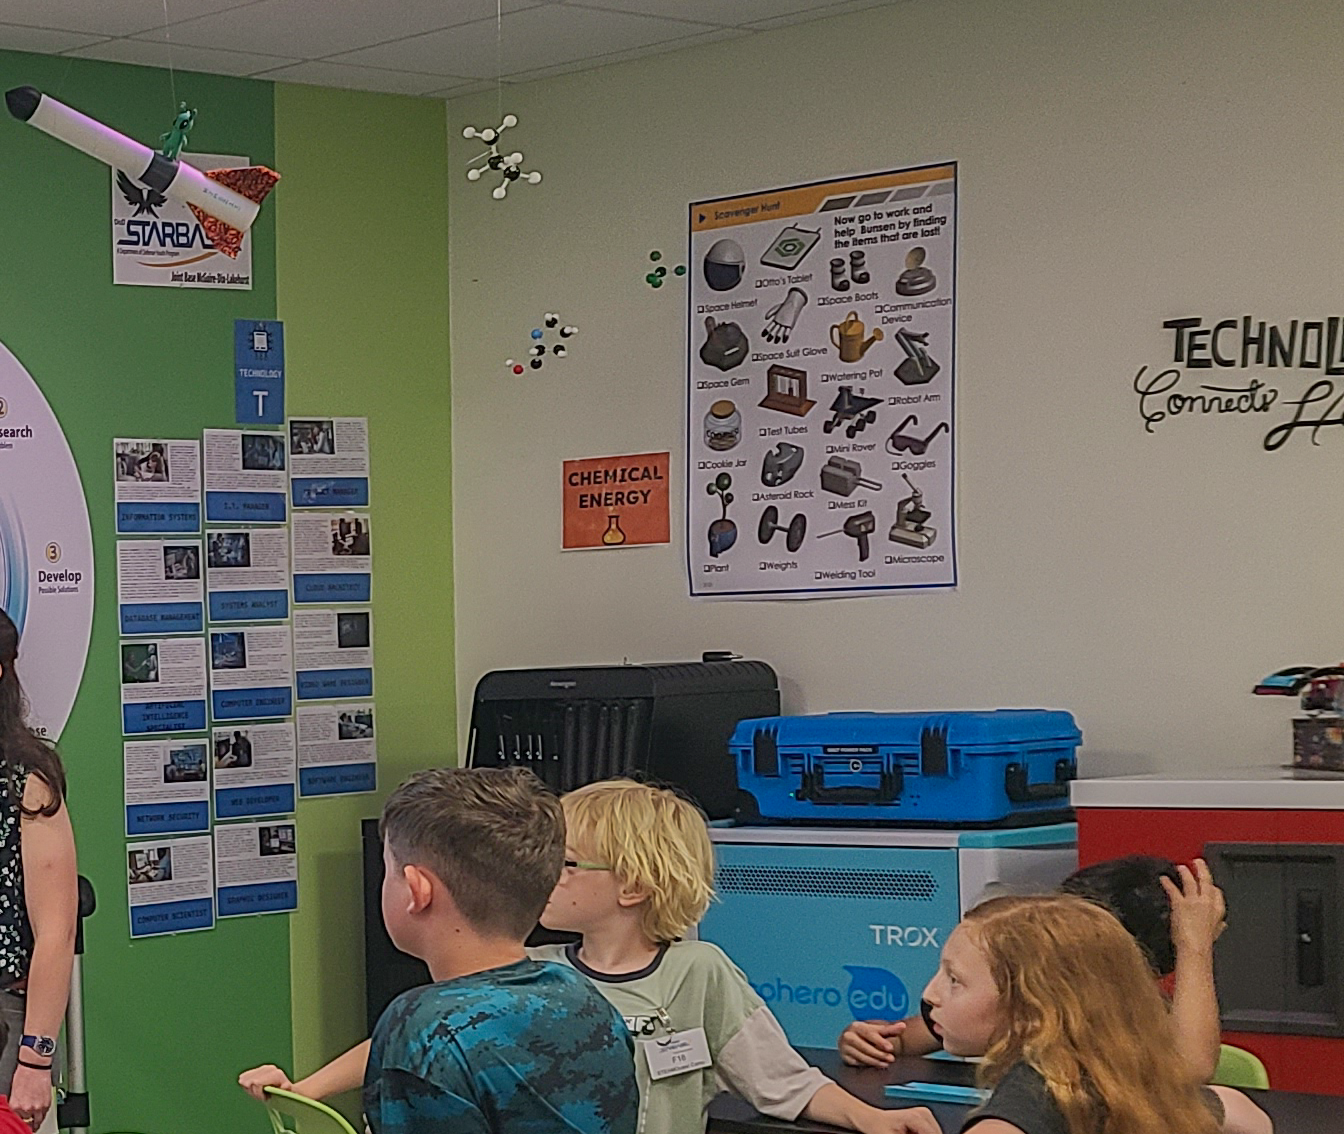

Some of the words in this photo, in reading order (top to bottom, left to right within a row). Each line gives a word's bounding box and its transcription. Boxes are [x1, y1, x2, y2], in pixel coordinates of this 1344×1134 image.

[715, 203, 759, 221] Scavenger
[761, 201, 781, 215] Hunt
[834, 213, 856, 225] Now
[858, 213, 871, 225] go
[873, 210, 883, 221] to
[886, 207, 910, 219] work
[912, 204, 932, 215] and
[117, 220, 216, 249] STARBA
[834, 226, 855, 239] help
[861, 221, 896, 236] Bunsen
[898, 219, 910, 231] by
[913, 214, 947, 229] finding
[834, 238, 850, 249] the
[852, 234, 878, 247] items
[881, 232, 899, 243] that
[902, 230, 918, 241] are
[920, 226, 941, 238] lost!
[788, 273, 813, 284] Tablet
[1163, 315, 1344, 375] TECHNOL
[240, 369, 282, 378] TECHNOLOGY
[829, 370, 866, 384] Watering
[868, 369, 883, 379] Pot
[253, 391, 268, 416] T
[766, 427, 782, 436] Test
[784, 424, 808, 435] Tubes
[705, 459, 733, 470] Cookie
[734, 458, 748, 468] Jar
[899, 459, 936, 472] Goggles
[568, 466, 664, 487] CHEMICAL
[578, 489, 652, 509] ENERGY
[766, 561, 798, 572] Weights
[892, 553, 945, 567] Microscope
[38, 569, 82, 584] Develop
[859, 570, 876, 580] Tool
[869, 924, 940, 948] TROX
[849, 986, 905, 1011] edu
